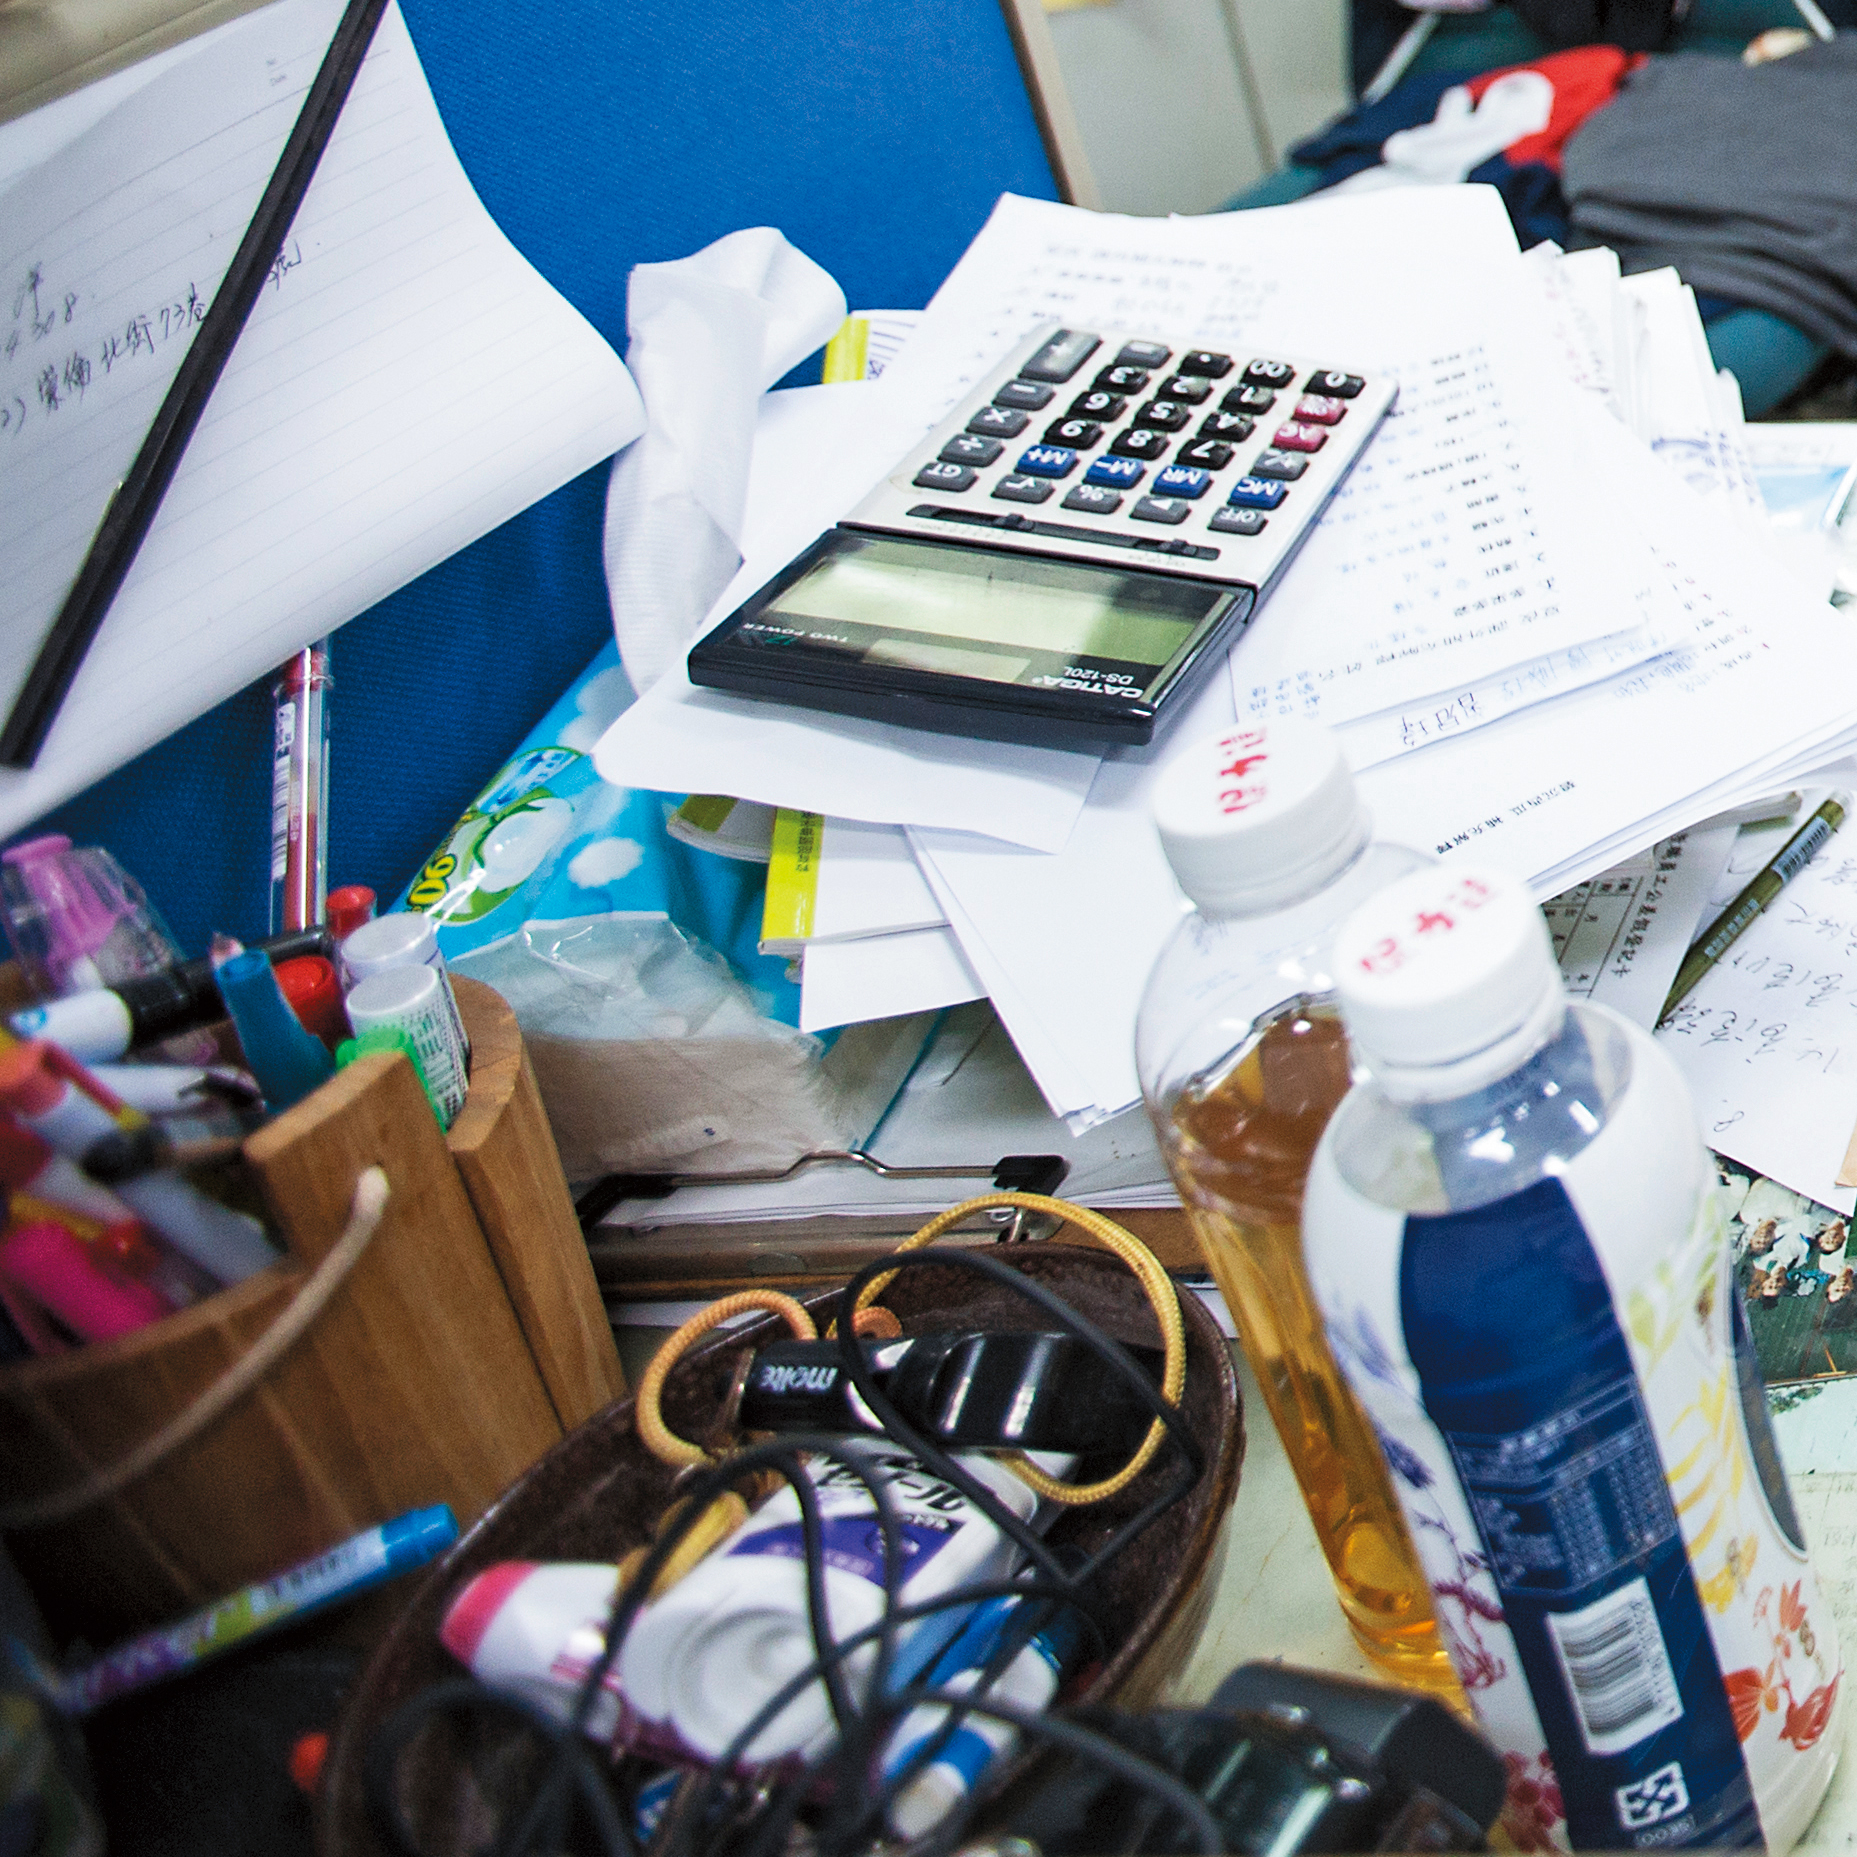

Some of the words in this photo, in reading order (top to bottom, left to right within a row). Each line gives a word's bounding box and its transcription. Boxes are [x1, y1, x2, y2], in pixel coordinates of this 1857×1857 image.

[1110, 366, 1135, 383] 3
[1251, 360, 1285, 376] 00
[1325, 372, 1347, 387] 0
[1085, 393, 1109, 409] 6
[1241, 384, 1254, 403] 1
[1150, 402, 1174, 419] 5
[1061, 420, 1087, 436] 9
[1216, 412, 1241, 429] 4
[1127, 430, 1151, 447] 8
[1025, 448, 1069, 465] M+
[1190, 442, 1214, 458] 7
[927, 463, 962, 478] GT
[1162, 467, 1202, 484] MR
[1236, 478, 1280, 495] MC
[1218, 509, 1257, 523] OFF
[743, 623, 806, 638] POWER
[809, 632, 848, 643] TWO
[1063, 666, 1134, 684] DS-120L
